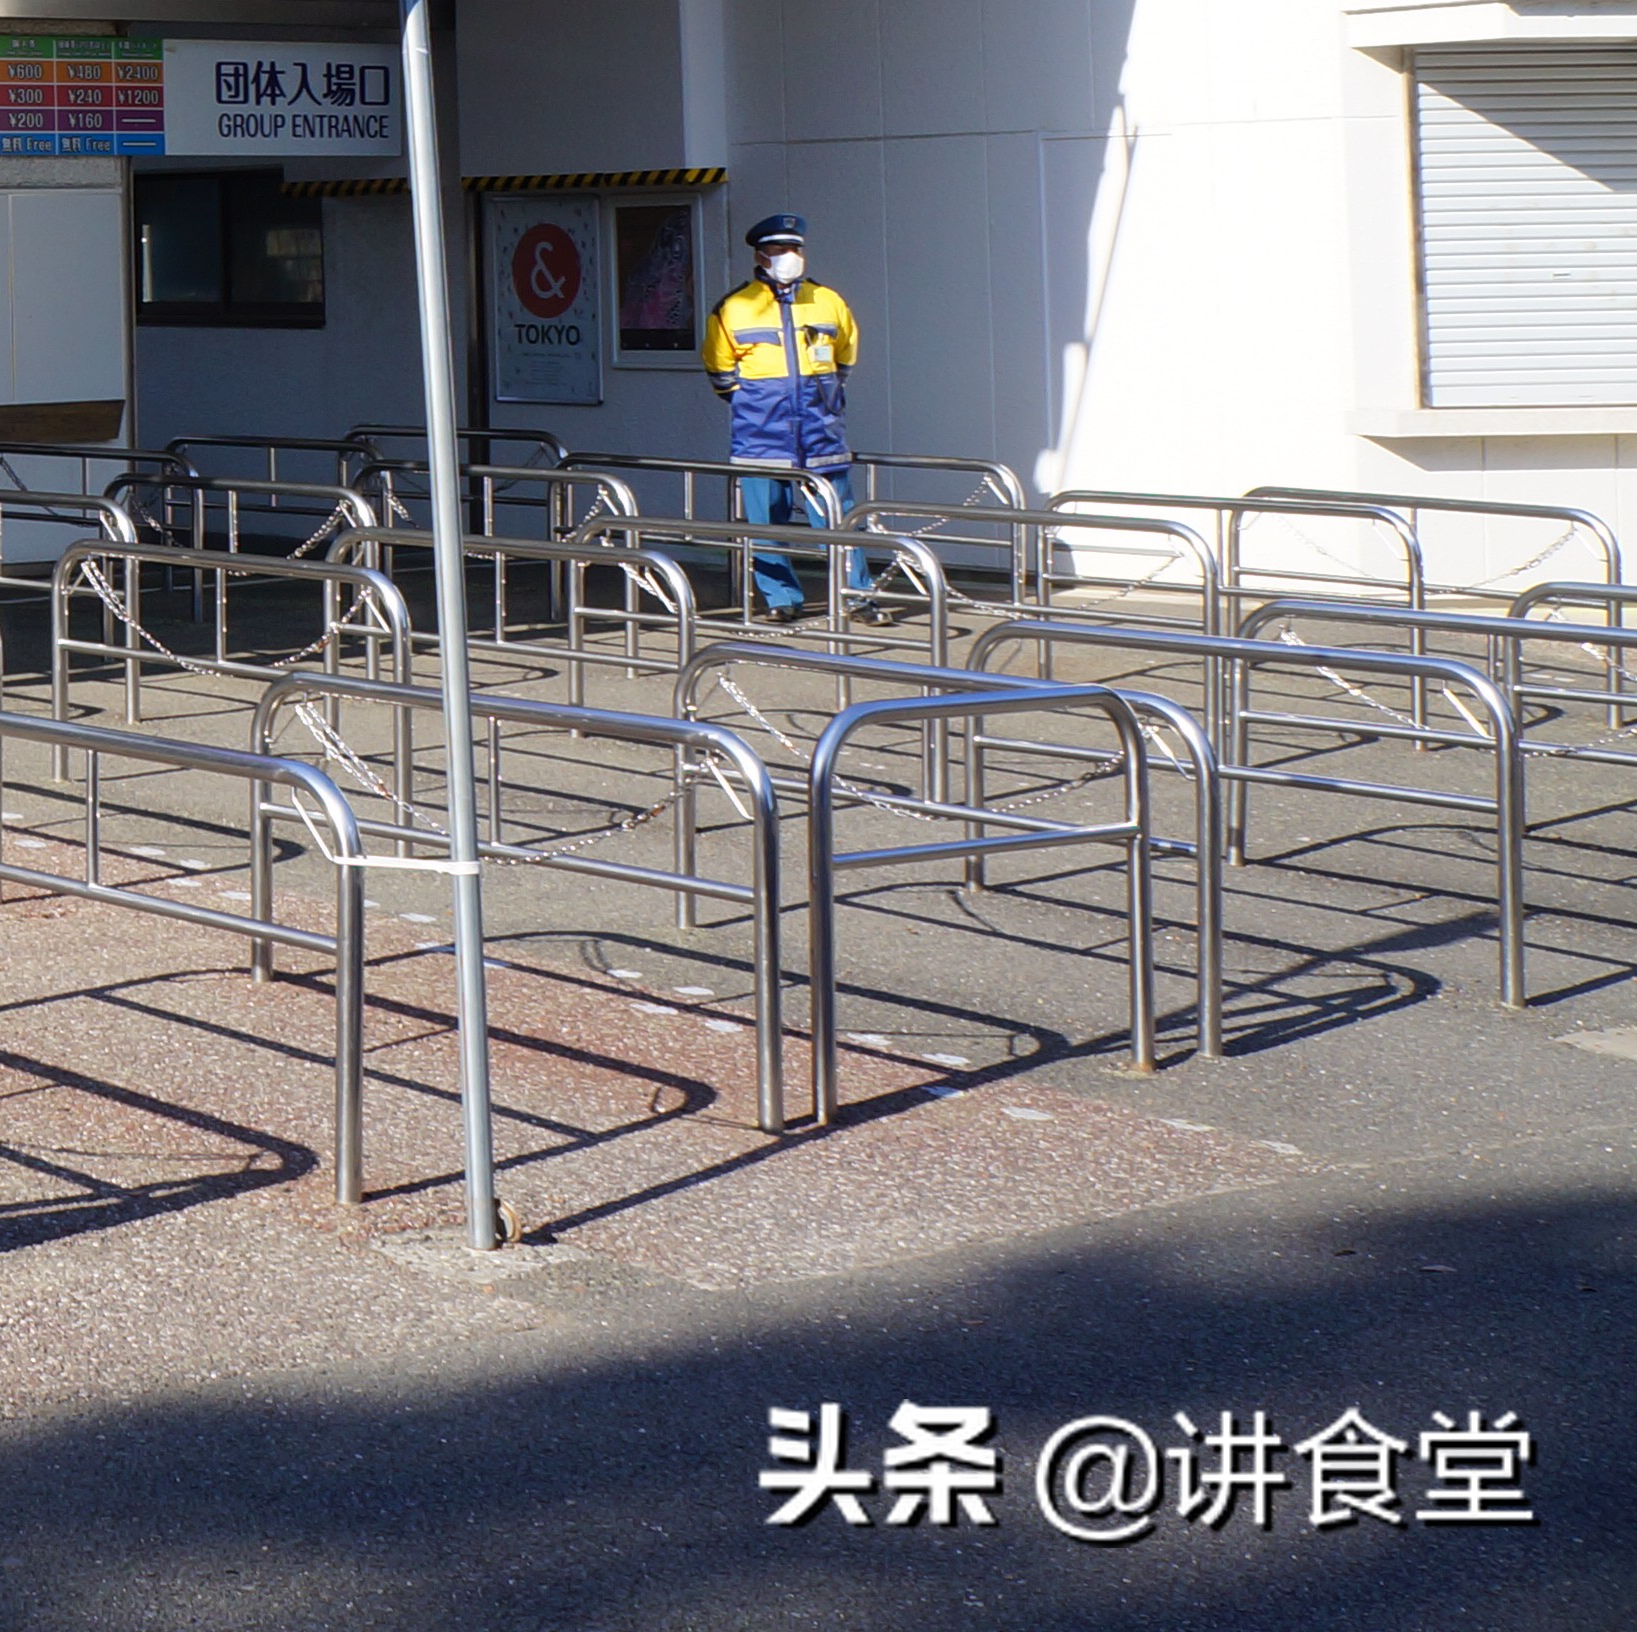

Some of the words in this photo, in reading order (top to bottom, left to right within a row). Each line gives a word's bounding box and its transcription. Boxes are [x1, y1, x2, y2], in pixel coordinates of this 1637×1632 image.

[8, 64, 42, 79] ¥600
[68, 65, 100, 79] ¥480
[117, 65, 158, 80] ¥2400
[214, 60, 390, 108] 団体入場口
[8, 89, 42, 104] ¥300
[69, 89, 101, 104] ¥240
[118, 90, 159, 104] ¥1200
[9, 113, 43, 128] ¥200
[69, 114, 102, 128] ¥160
[217, 113, 287, 139] GROUP
[292, 113, 389, 139] ENTRANCE
[27, 138, 52, 151] Free
[86, 138, 110, 152] Free
[514, 324, 580, 345] TOKYO
